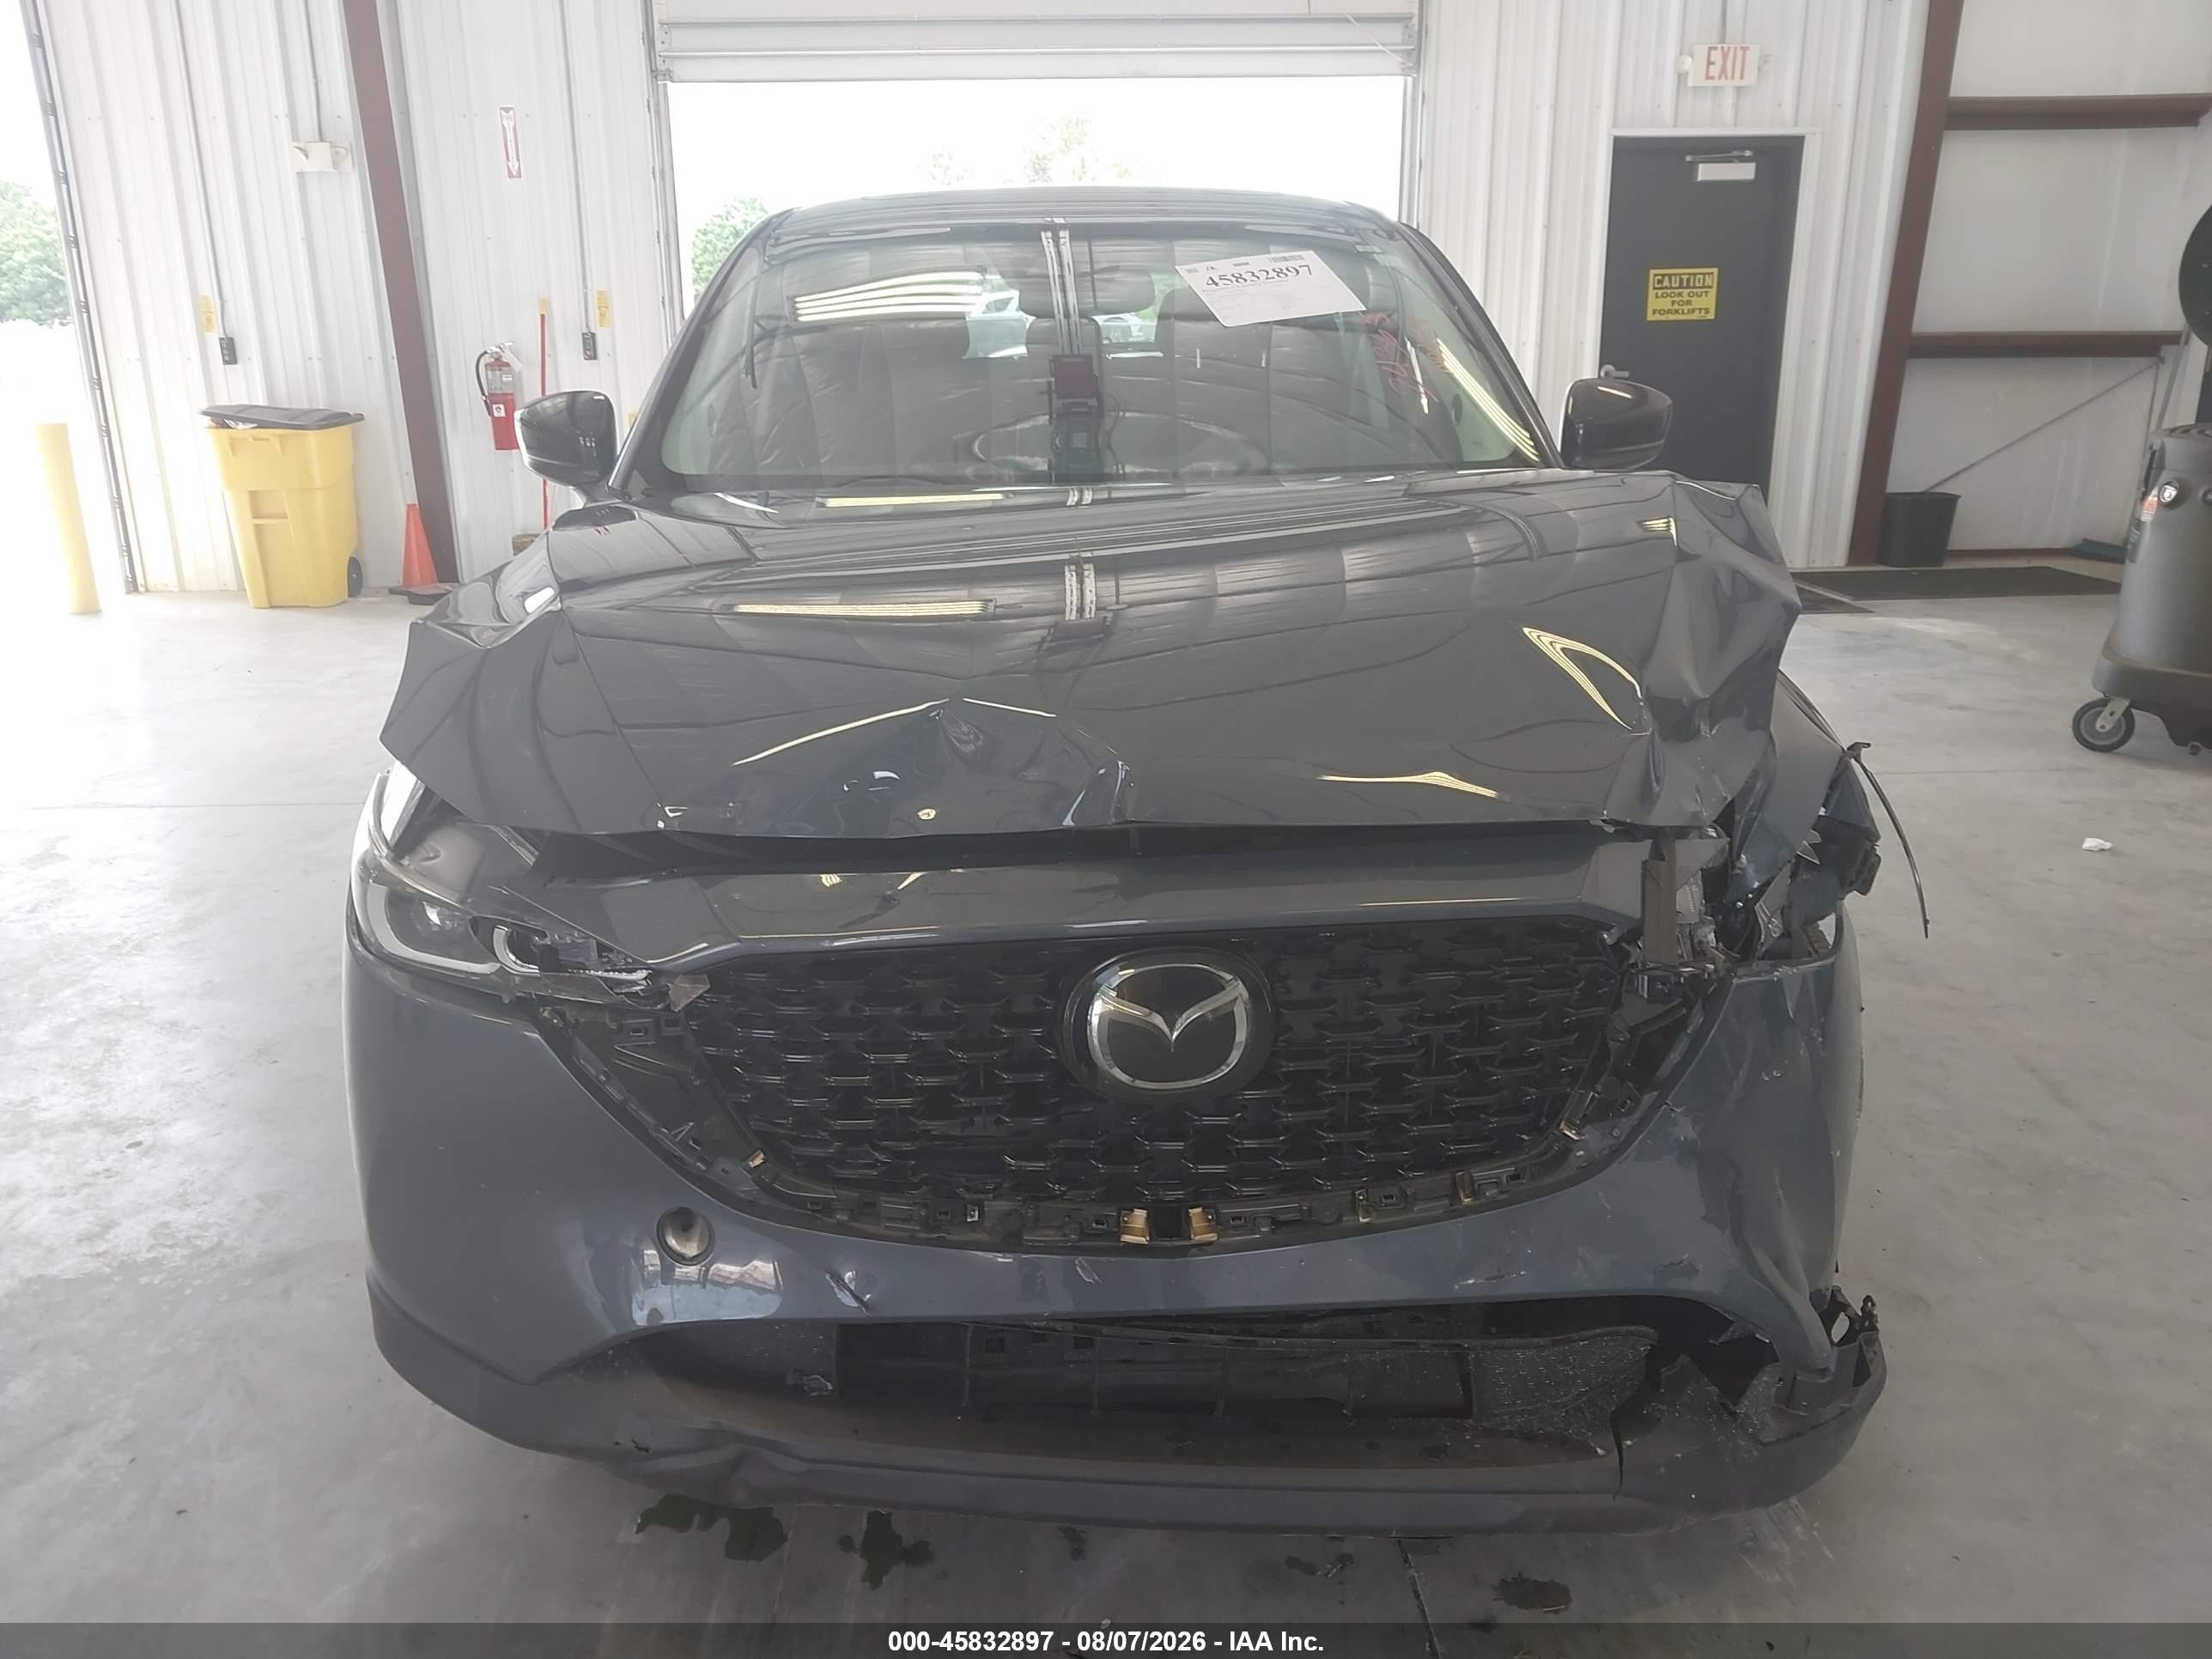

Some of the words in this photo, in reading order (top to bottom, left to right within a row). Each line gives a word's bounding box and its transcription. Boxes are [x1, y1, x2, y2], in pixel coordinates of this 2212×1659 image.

[1705, 46, 1750, 81] EXIT
[1206, 264, 1313, 288] 45832897
[1654, 274, 1713, 289] CAUTION
[1687, 290, 1711, 299] OUT
[1671, 299, 1692, 307] FOR
[1652, 307, 1711, 316] FORKLIFTS
